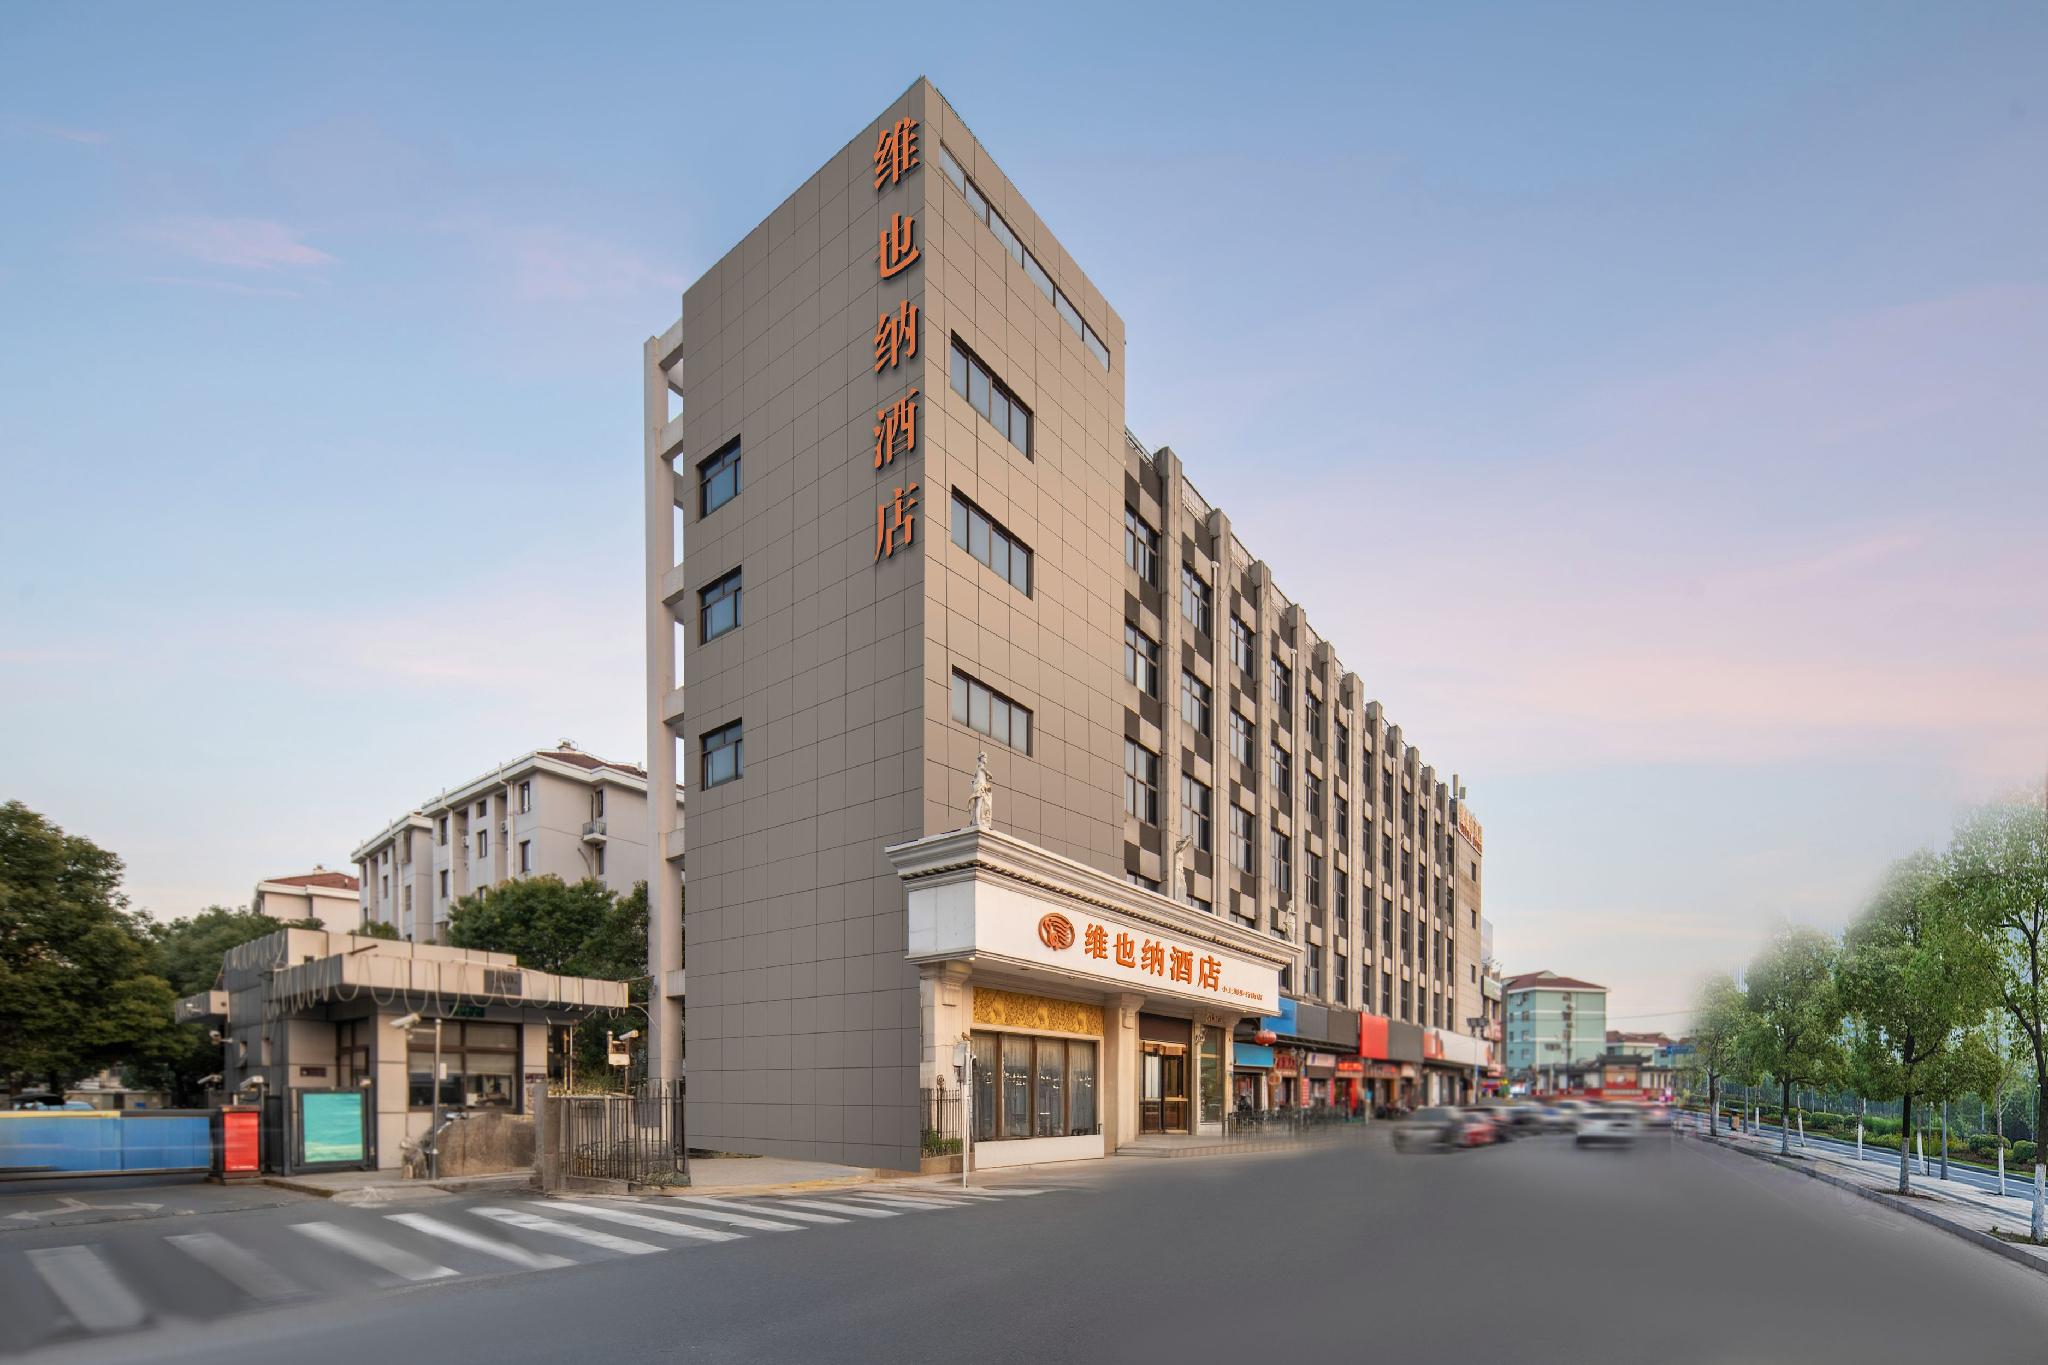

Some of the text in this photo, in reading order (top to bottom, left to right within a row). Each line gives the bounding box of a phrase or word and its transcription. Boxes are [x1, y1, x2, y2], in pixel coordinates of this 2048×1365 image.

[873, 117, 920, 562] 维也纳酒店
[1084, 923, 1221, 991] 维也纳酒店
